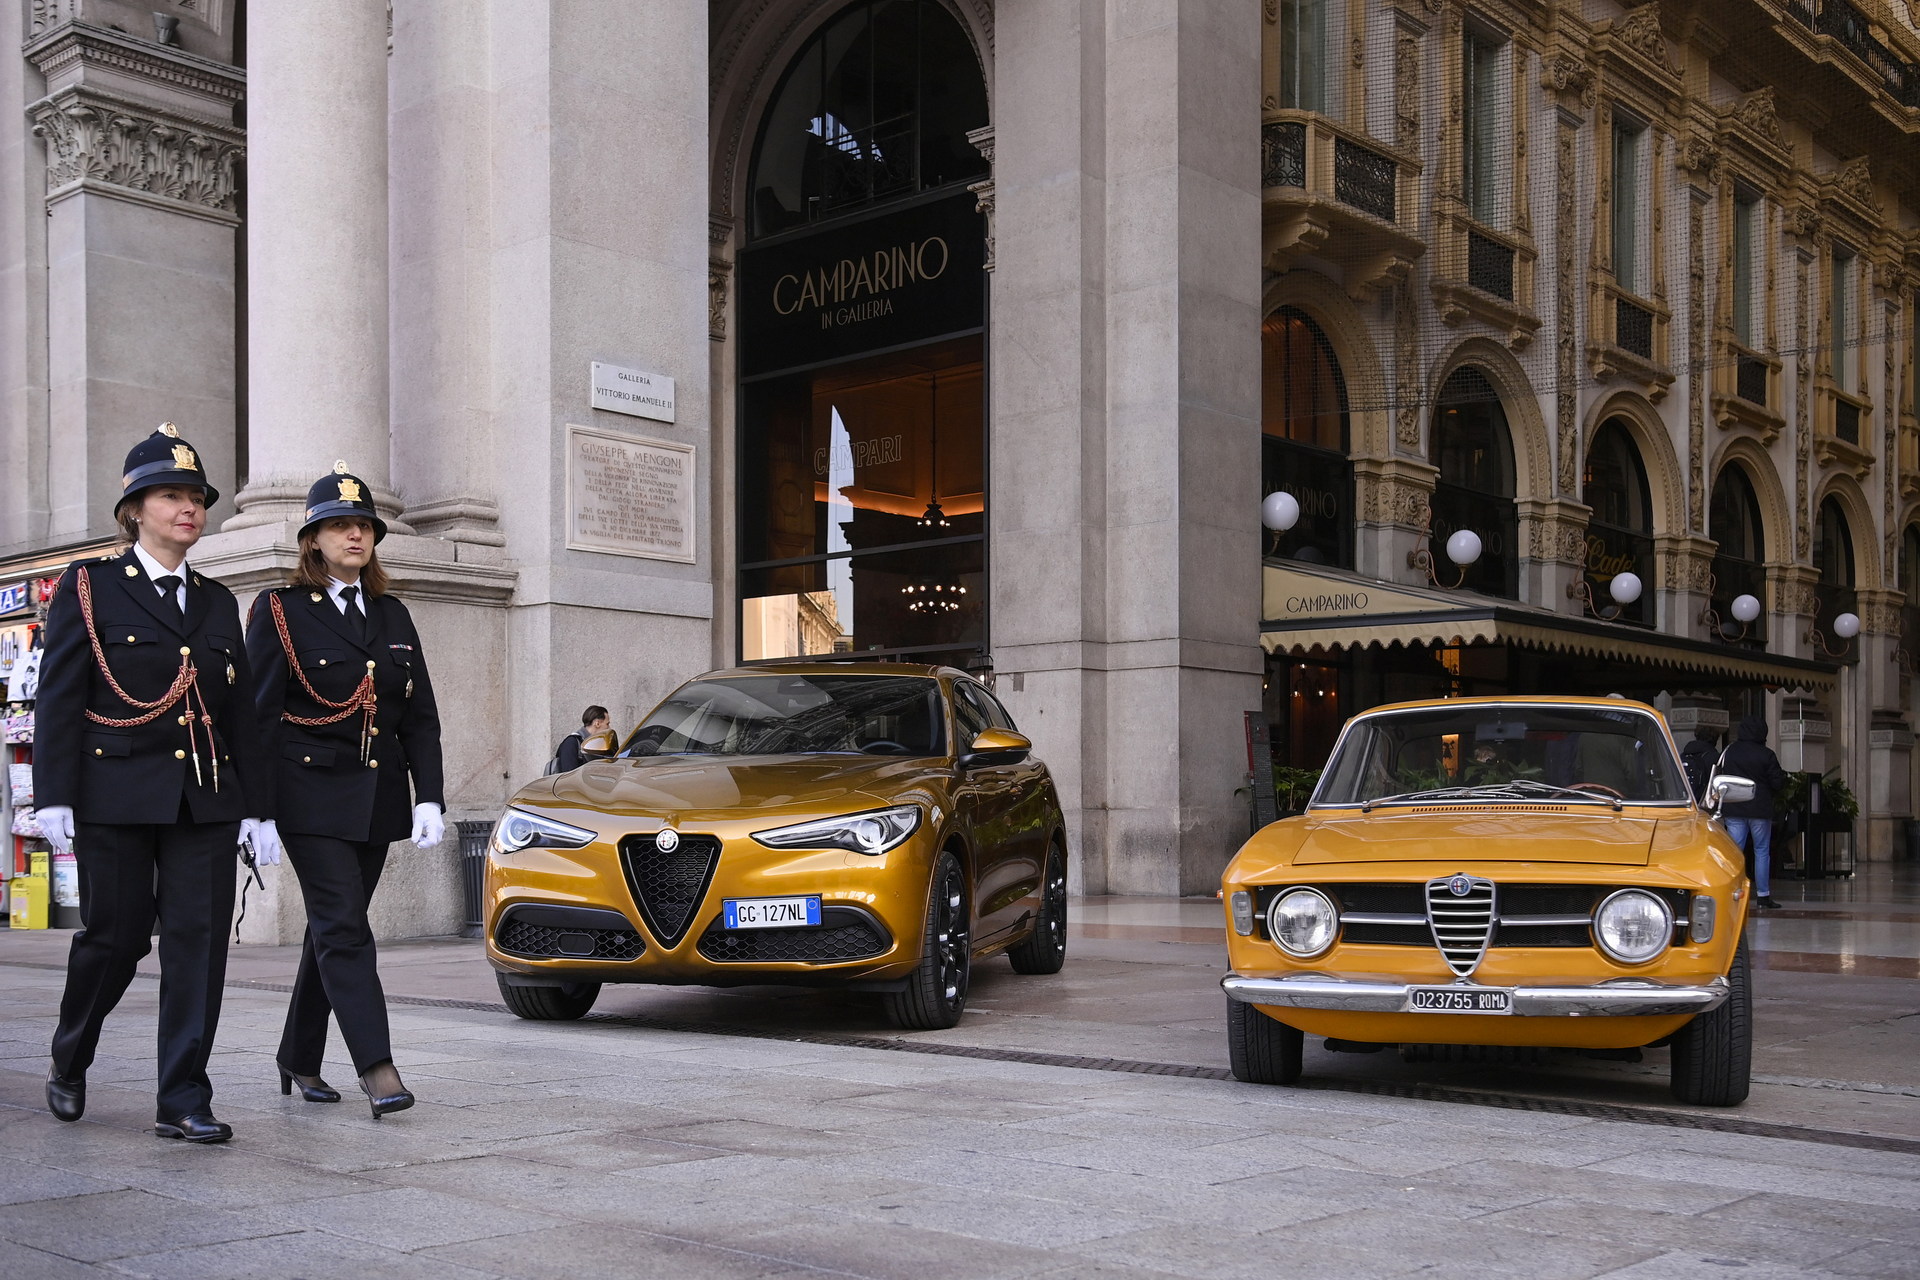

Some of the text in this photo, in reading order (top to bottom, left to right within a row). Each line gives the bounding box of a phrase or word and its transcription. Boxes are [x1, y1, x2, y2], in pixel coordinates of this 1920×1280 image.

[773, 236, 948, 315] CAMPARINO
[822, 298, 893, 329] IN GALLERIA
[618, 373, 650, 385] GALLERIA
[596, 387, 630, 400] VITTORIO
[632, 394, 666, 408] EMANUELE
[581, 443, 681, 468] GIVSEPPE MENGONI
[814, 434, 902, 475] CAMPARI
[625, 490, 647, 498] ALLORA
[650, 495, 677, 504] LIBERATA
[597, 508, 618, 516] CAMPO
[620, 527, 646, 535] DICEMBRE
[660, 524, 684, 533] VITTORIA
[627, 535, 654, 544] MERITATO
[657, 538, 682, 547] TRIONFO
[1286, 592, 1368, 613] CAMPARINO
[739, 906, 756, 922] GG
[763, 904, 805, 921] 127NL
[1479, 994, 1505, 1009] ROMA
